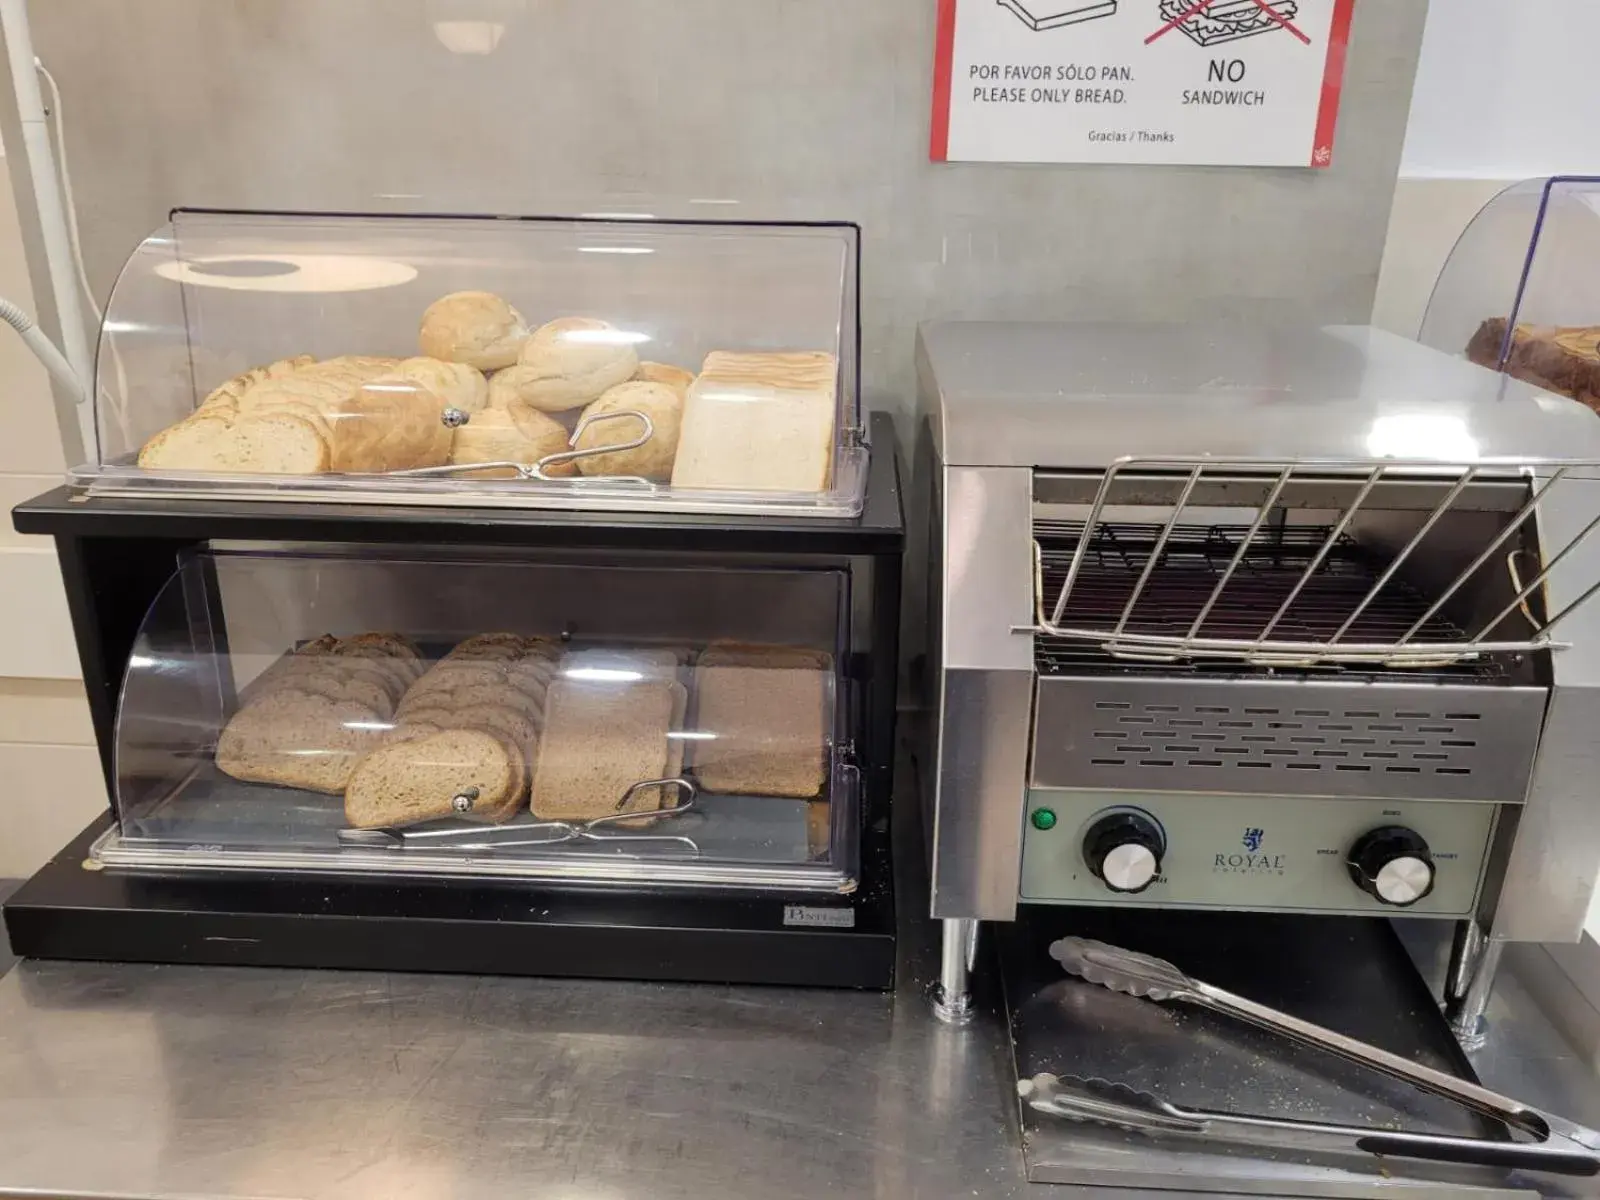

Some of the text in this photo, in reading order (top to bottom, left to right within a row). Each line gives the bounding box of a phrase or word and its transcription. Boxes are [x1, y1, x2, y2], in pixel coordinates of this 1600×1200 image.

[969, 63, 1135, 82] POR FAVOR SÓLO PAN.
[1207, 58, 1246, 83] NO
[973, 86, 1127, 104] PLEASE ONLY BREAD.
[1181, 89, 1265, 106] SANDWICH
[1088, 130, 1127, 142] Gracias
[1137, 131, 1175, 143] Thanks
[1214, 853, 1285, 869] ROYAL
